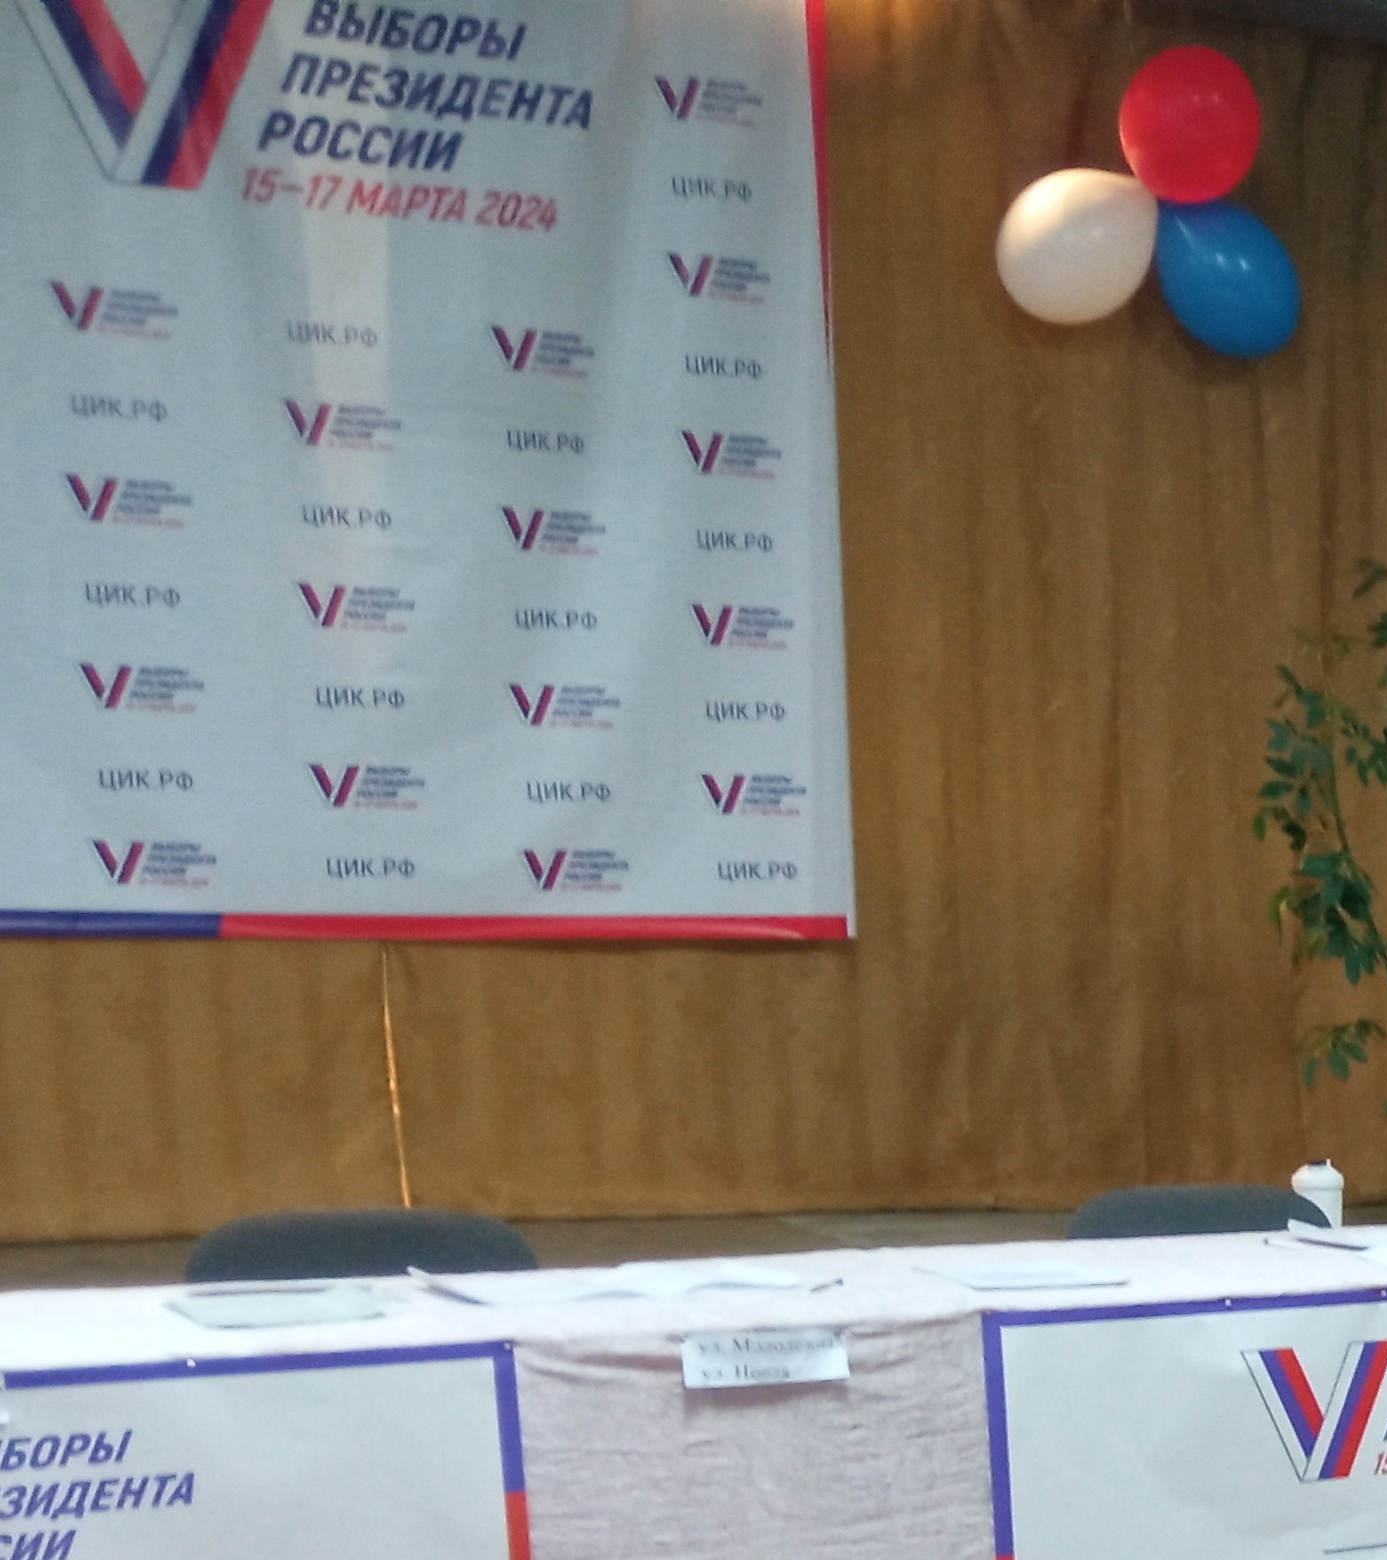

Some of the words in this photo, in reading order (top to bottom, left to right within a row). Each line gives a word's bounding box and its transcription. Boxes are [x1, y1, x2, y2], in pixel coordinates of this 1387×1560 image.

[304, 0, 527, 60] ВЫБОРЫ
[280, 52, 593, 130] ПРЕЗИДЕНТА
[257, 109, 463, 172] РОССИИ
[672, 176, 753, 203] ЦИК.РФ
[346, 178, 467, 223] МАРТА
[474, 189, 558, 233] 2024
[286, 321, 378, 349] ЦИК.РФ
[685, 355, 762, 380] ЦИК.РФ
[69, 394, 168, 422] ЦИК.РФ
[507, 429, 585, 455] ЦИК.РФ
[301, 503, 392, 530] ЦИК.РФ
[696, 529, 773, 553] ЦИК.РФ
[84, 582, 181, 608] ЦИК.РФ
[513, 606, 597, 633] ЦИК.РФ
[315, 686, 406, 711] ЦИК.РФ
[705, 700, 786, 723] ЦИК.РФ
[97, 768, 194, 793] ЦИК.РФ
[526, 781, 613, 805] ЦИК.РФ
[326, 857, 416, 880] ЦИК.РФ
[717, 861, 798, 884] ЦИК.РФ
[0, 1429, 133, 1472] БОРЫ
[0, 1472, 195, 1521] ЗИДЕНТА
